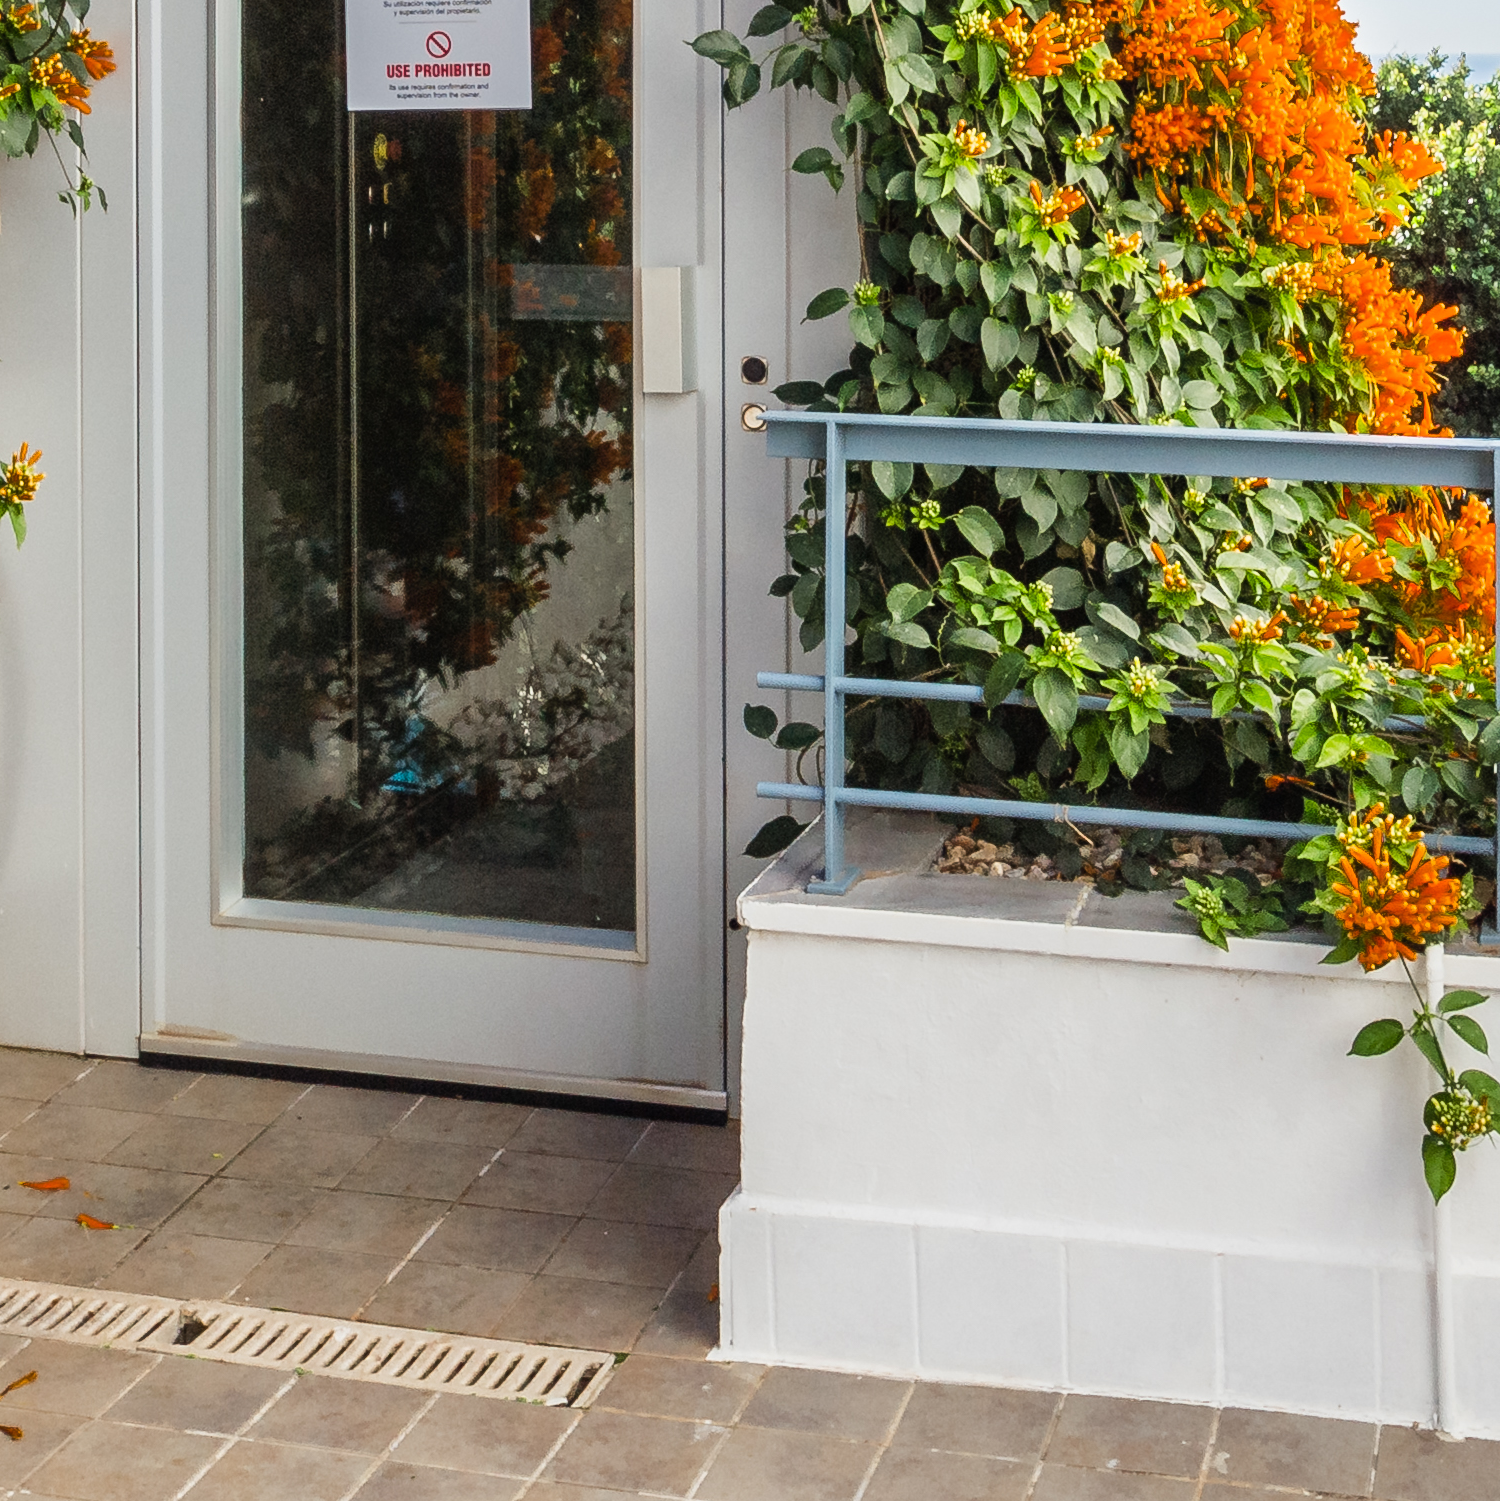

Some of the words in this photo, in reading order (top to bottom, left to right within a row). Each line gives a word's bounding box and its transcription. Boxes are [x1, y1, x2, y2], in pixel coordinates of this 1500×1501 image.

[386, 64, 411, 78] USE
[414, 63, 491, 78] PROHIBITED
[477, 82, 490, 90] and
[433, 91, 448, 99] from
